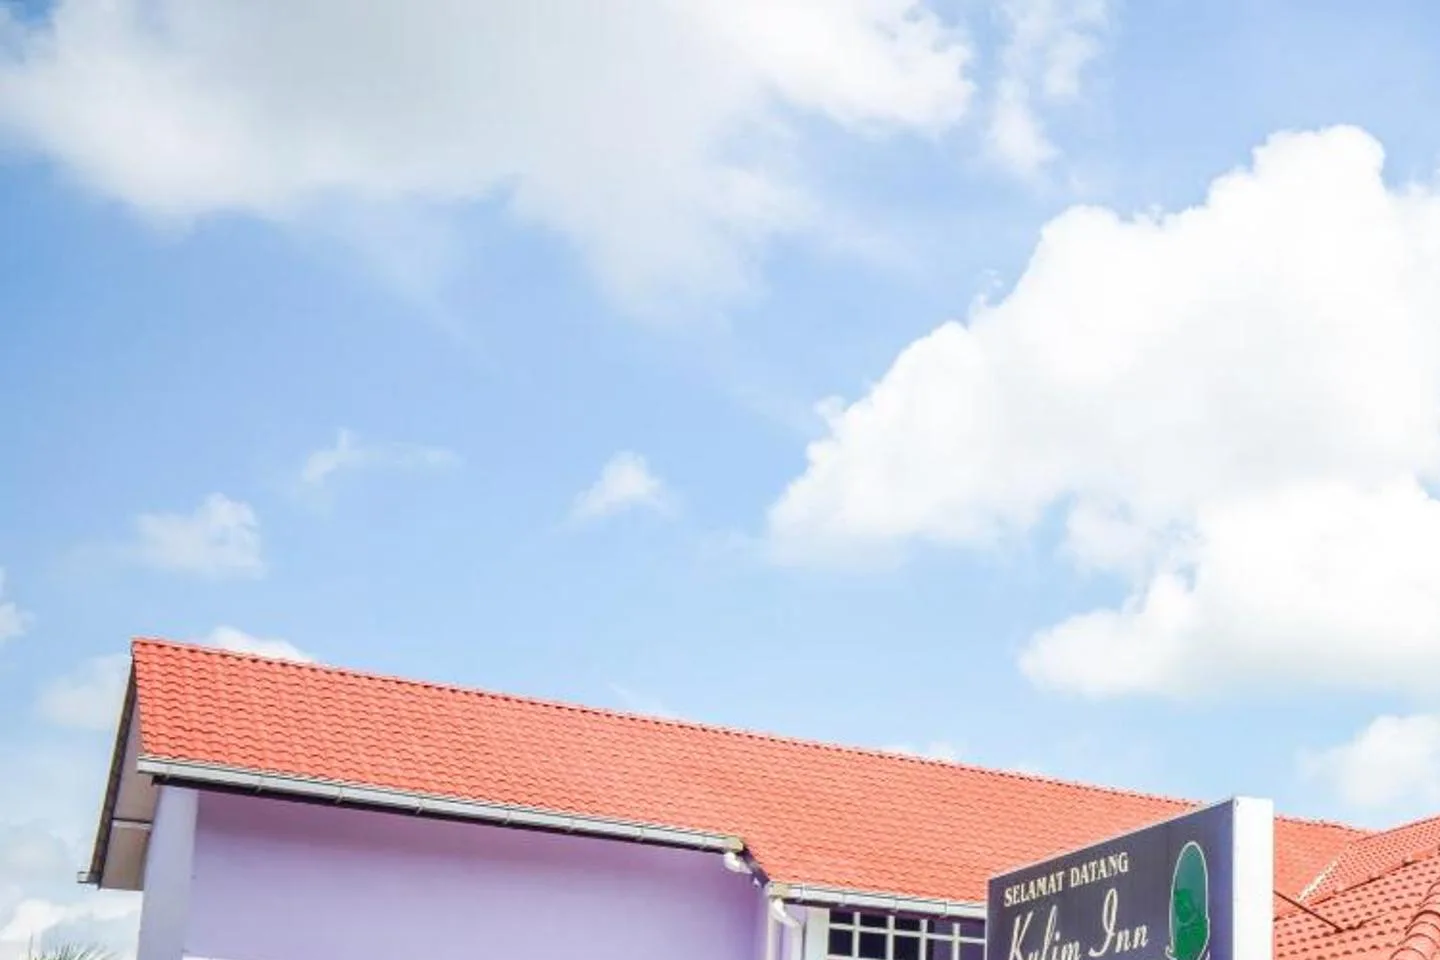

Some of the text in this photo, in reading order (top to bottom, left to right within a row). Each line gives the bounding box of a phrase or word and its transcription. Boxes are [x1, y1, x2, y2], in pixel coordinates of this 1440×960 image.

[1004, 852, 1129, 908] SELAMAT DATANG
[1088, 887, 1149, 958] Inn
